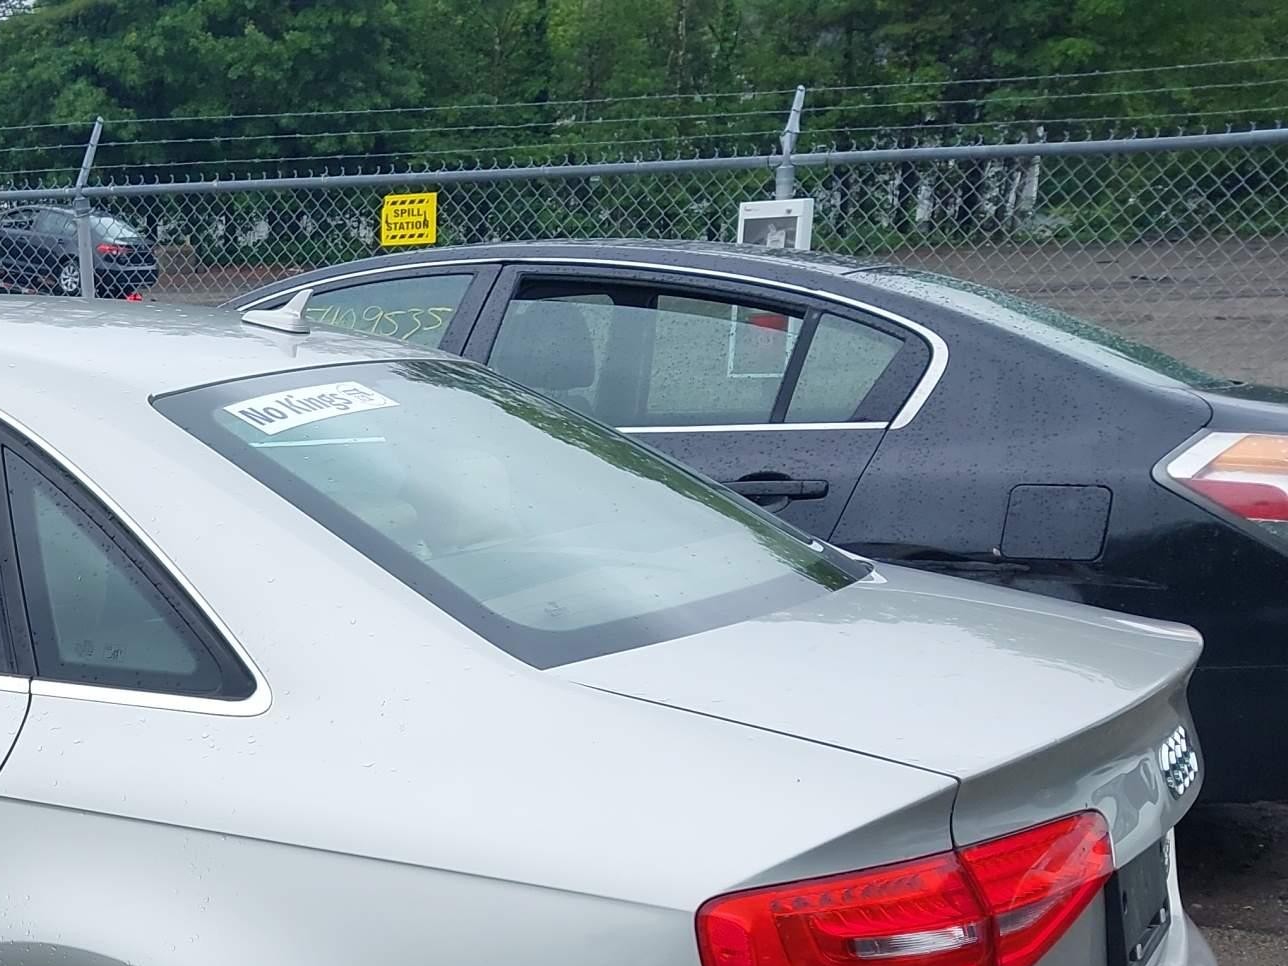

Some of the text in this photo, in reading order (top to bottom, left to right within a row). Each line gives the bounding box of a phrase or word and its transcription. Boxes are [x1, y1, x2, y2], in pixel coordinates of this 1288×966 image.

[393, 208, 423, 218] SPILL
[386, 220, 429, 231] STATION
[238, 407, 288, 426] No
[275, 393, 353, 415] Kings
